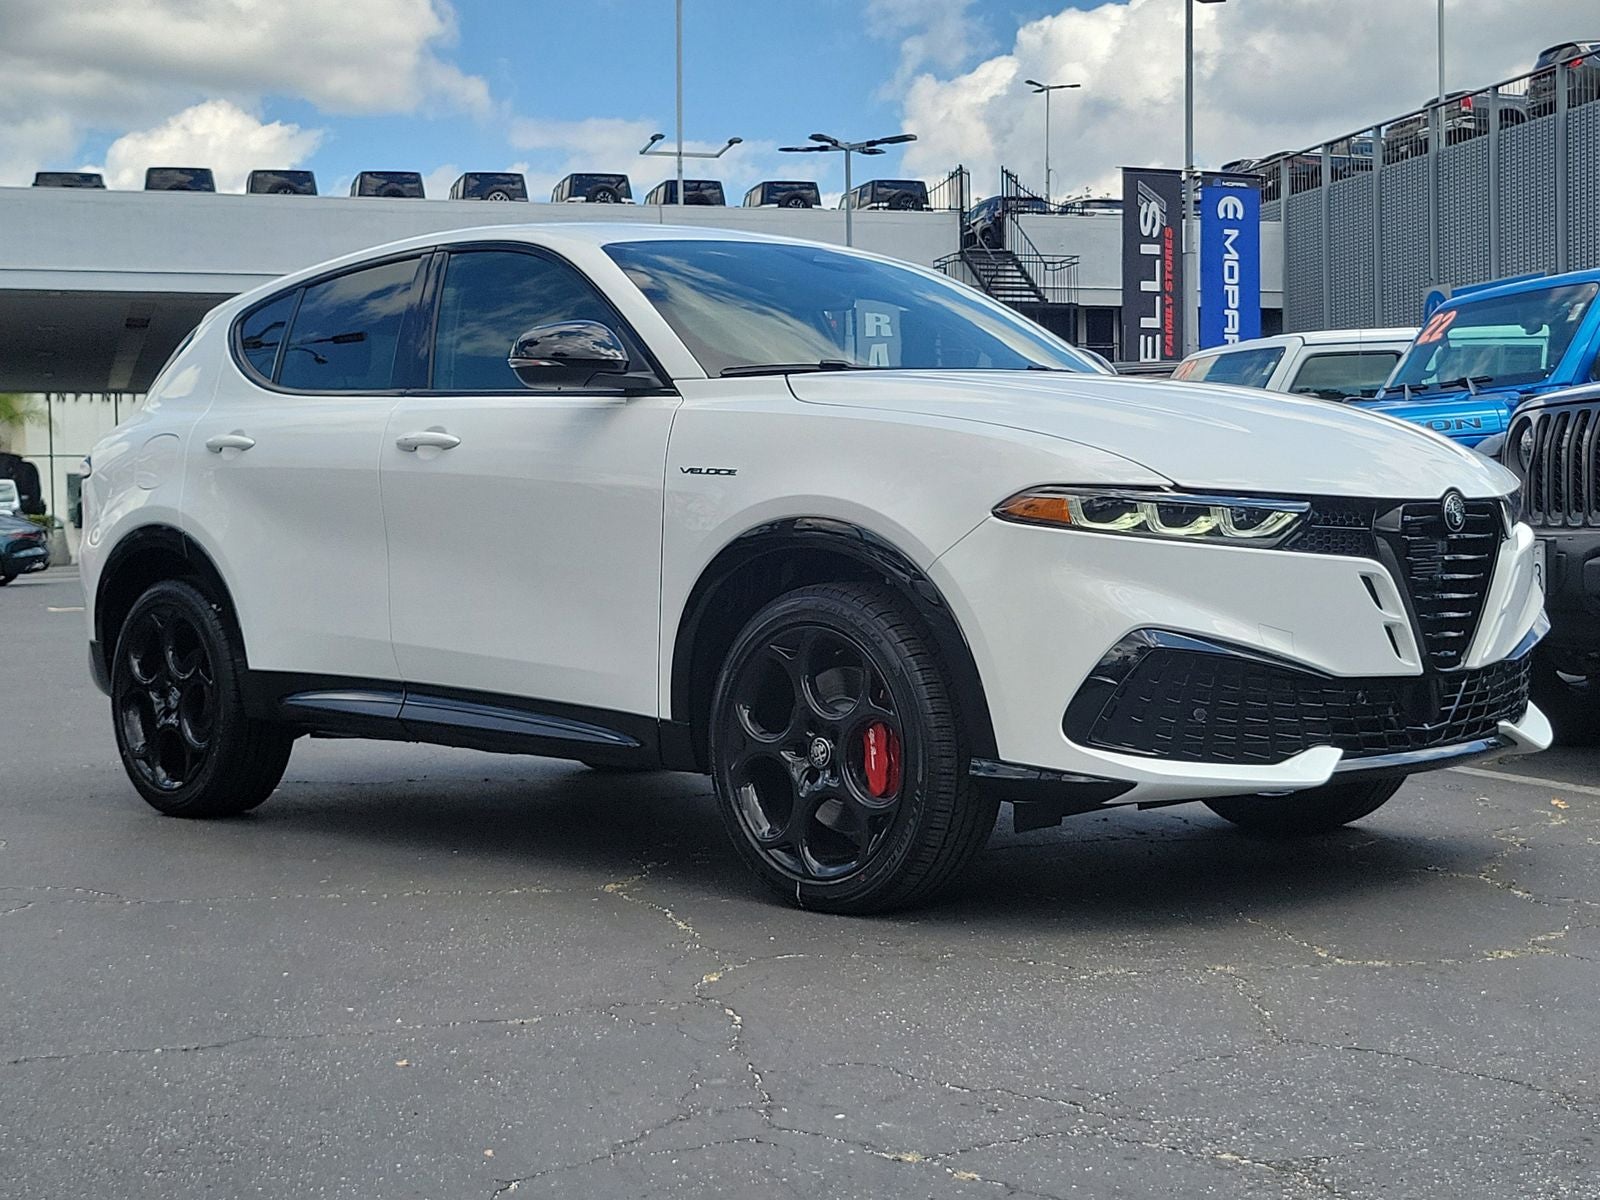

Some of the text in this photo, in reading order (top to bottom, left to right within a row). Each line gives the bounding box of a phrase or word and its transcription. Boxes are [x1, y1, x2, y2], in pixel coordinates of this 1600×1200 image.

[1140, 201, 1160, 362] ELLIS
[1164, 226, 1174, 357] FAMILY STORES
[679, 466, 738, 477] VELOCE
